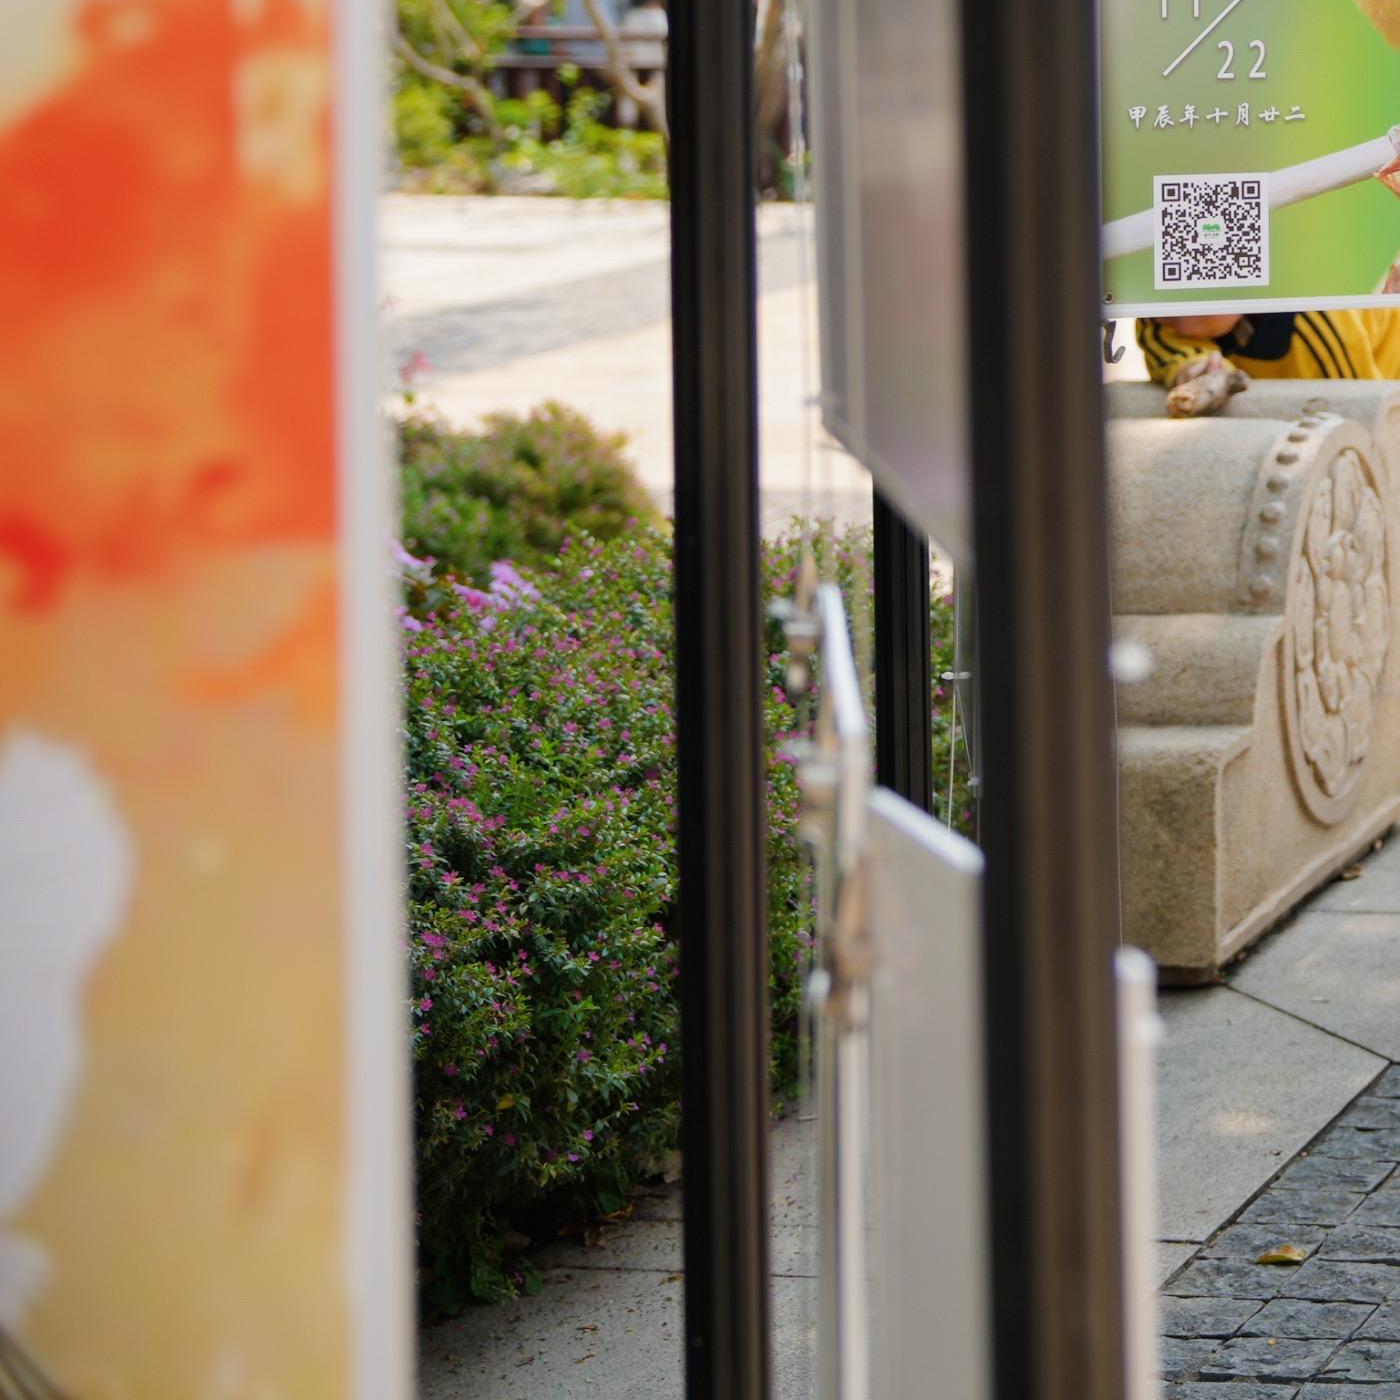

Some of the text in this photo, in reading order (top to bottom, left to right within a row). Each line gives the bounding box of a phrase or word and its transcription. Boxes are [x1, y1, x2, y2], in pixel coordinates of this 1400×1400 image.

[1127, 102, 1306, 130] 甲辰年十月廿二
